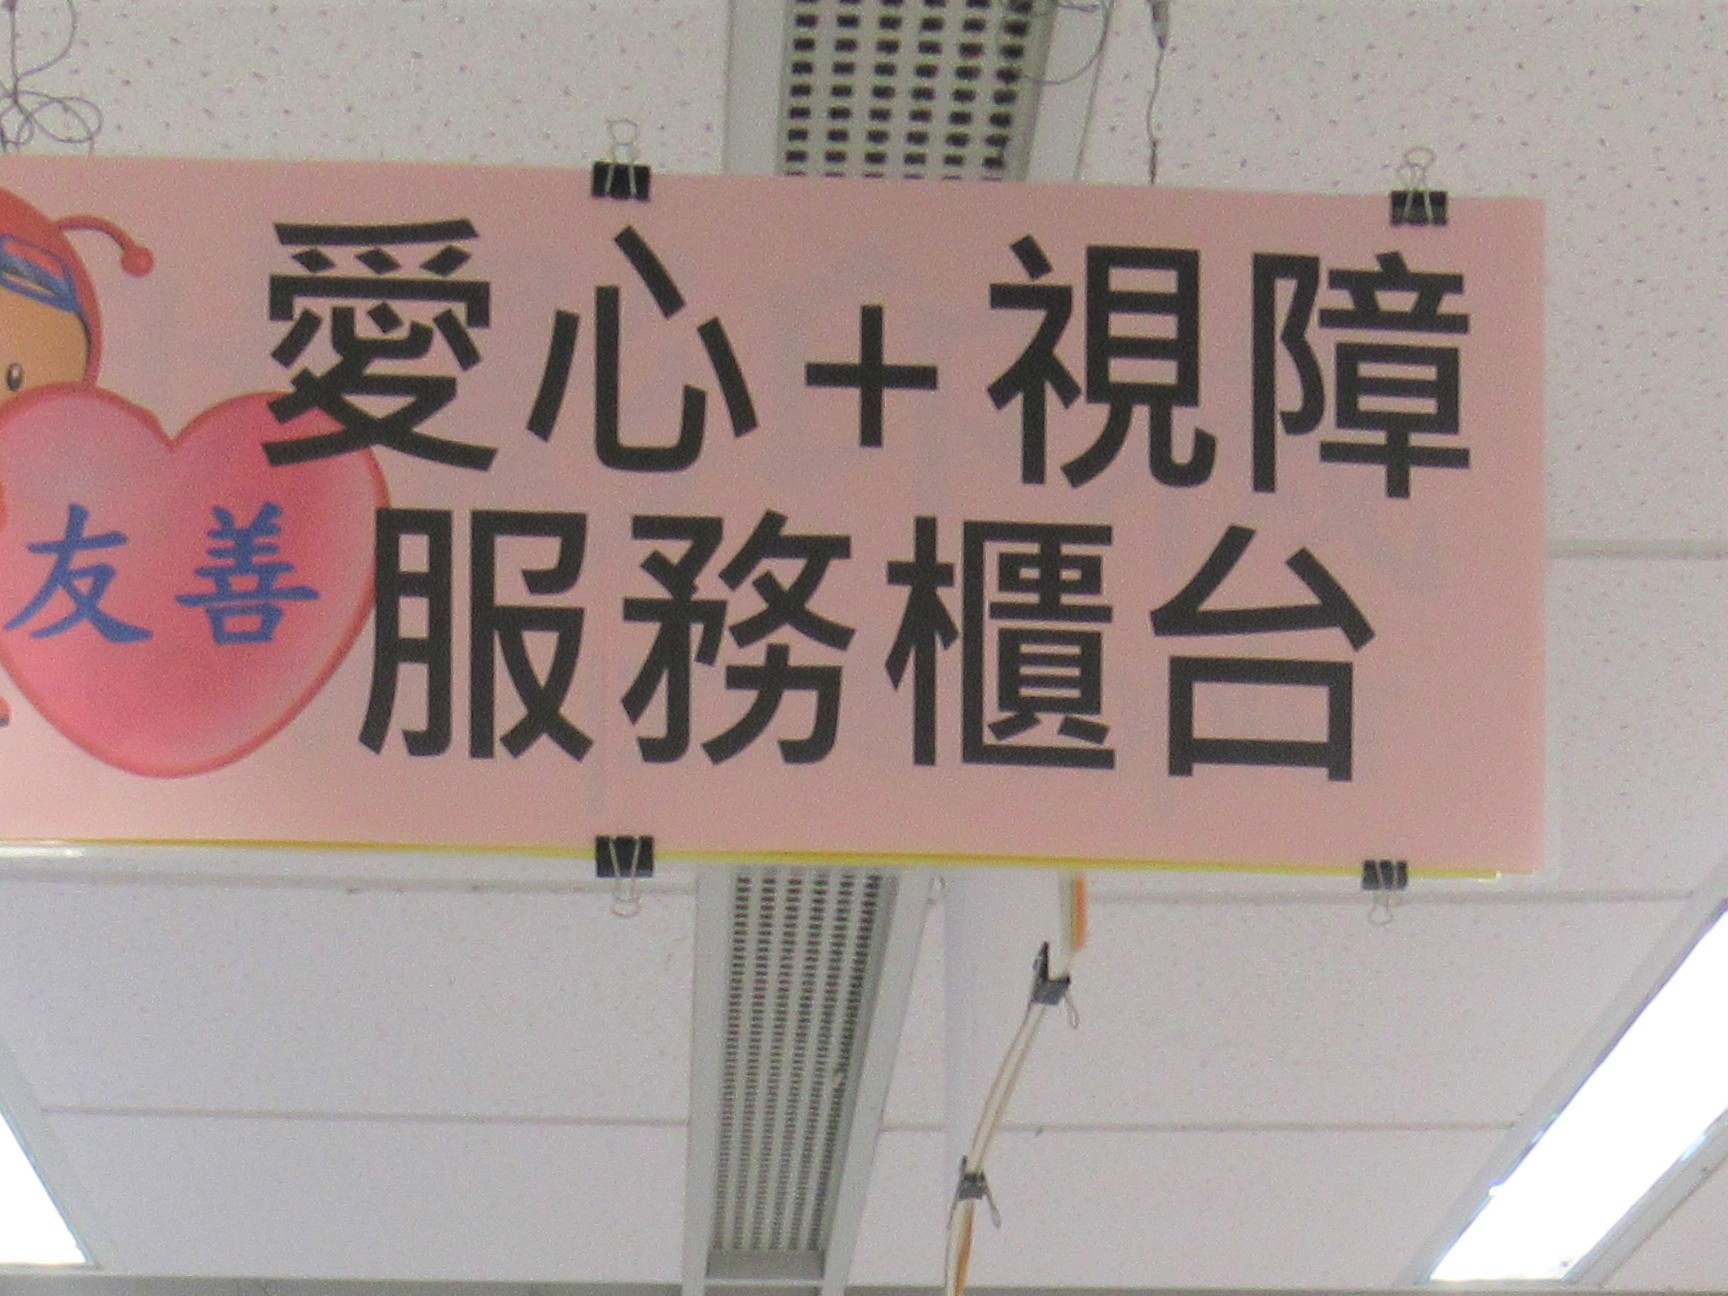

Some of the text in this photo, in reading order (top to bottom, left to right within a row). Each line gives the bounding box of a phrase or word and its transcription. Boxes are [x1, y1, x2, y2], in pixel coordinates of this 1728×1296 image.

[260, 212, 1477, 500] 愛心+視障
[3, 498, 323, 647] 友善
[355, 502, 1382, 786] 服務櫃台
